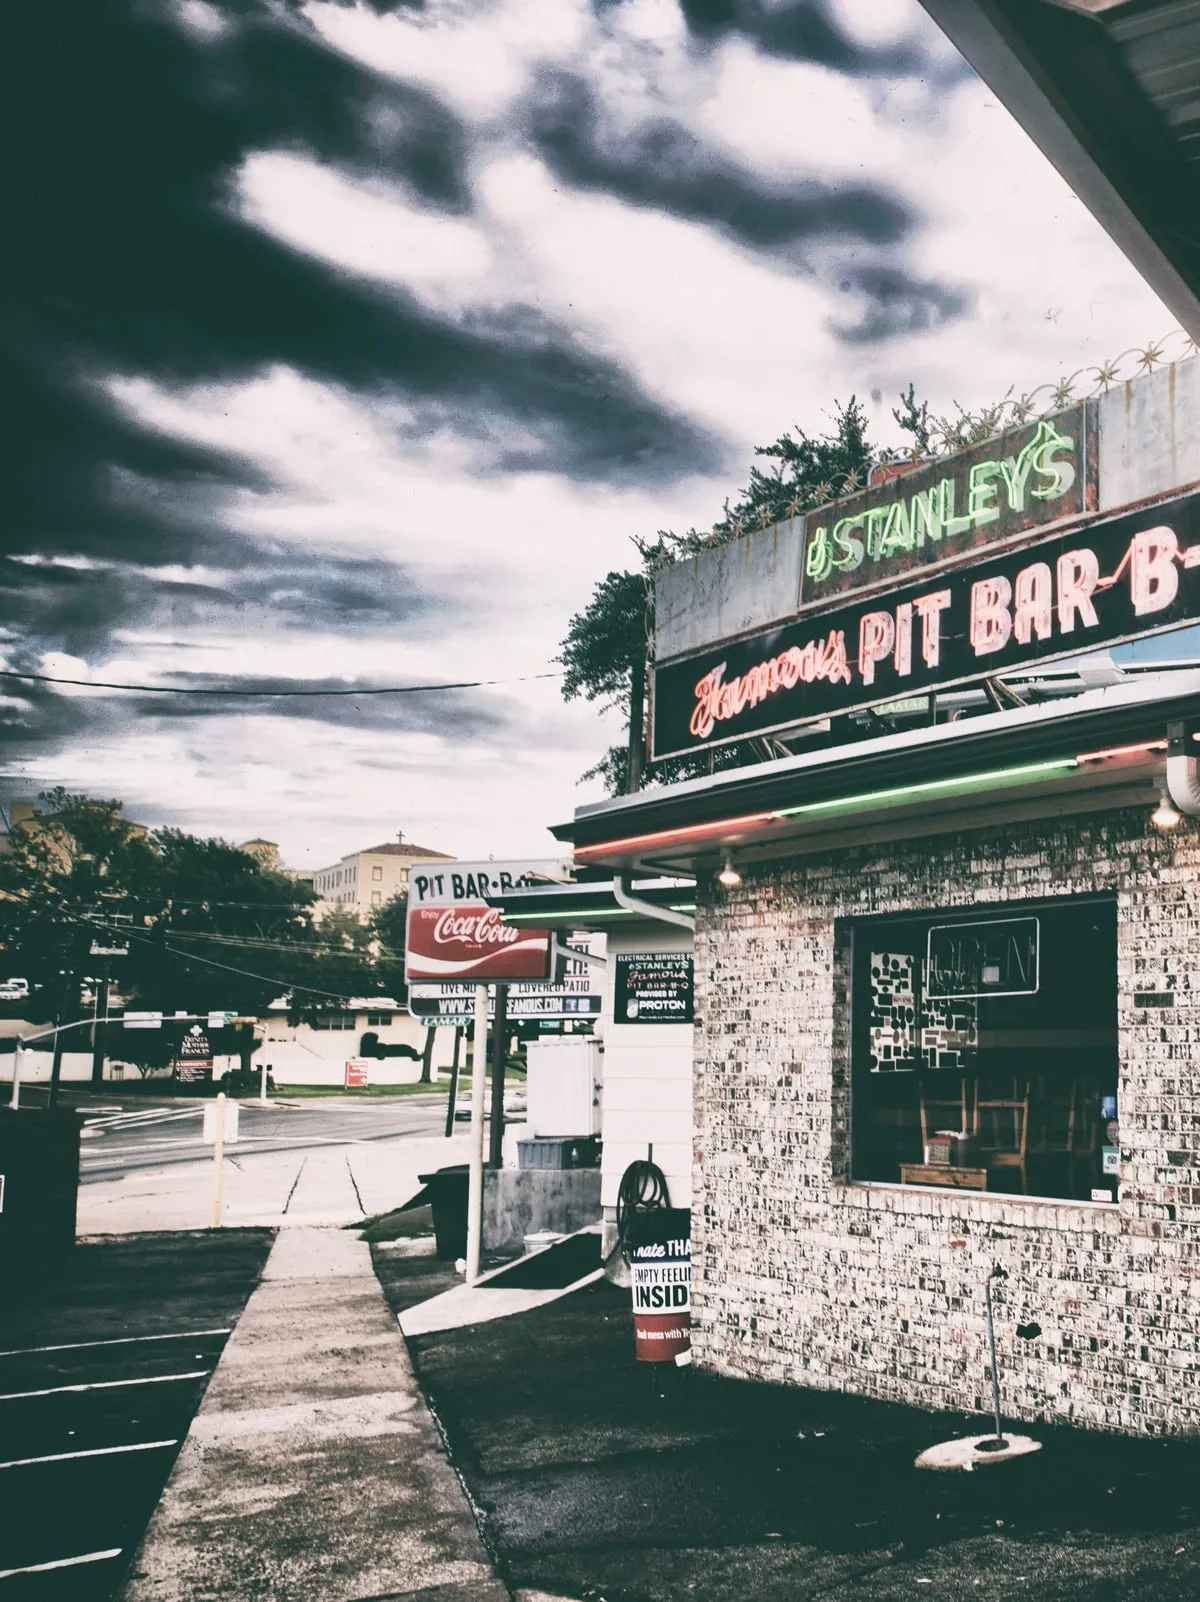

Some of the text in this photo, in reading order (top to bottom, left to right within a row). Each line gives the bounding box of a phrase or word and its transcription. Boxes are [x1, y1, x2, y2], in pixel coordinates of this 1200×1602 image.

[833, 420, 1076, 572] STANLEY'S
[689, 629, 851, 739] Famous
[858, 588, 953, 687] PIT
[415, 874, 445, 901] PIT
[627, 970, 688, 983] Famous
[639, 1000, 686, 1010] PROTON
[423, 1016, 468, 1026] LAMAR
[667, 1239, 691, 1256] THA
[636, 1285, 689, 1308] INSID
